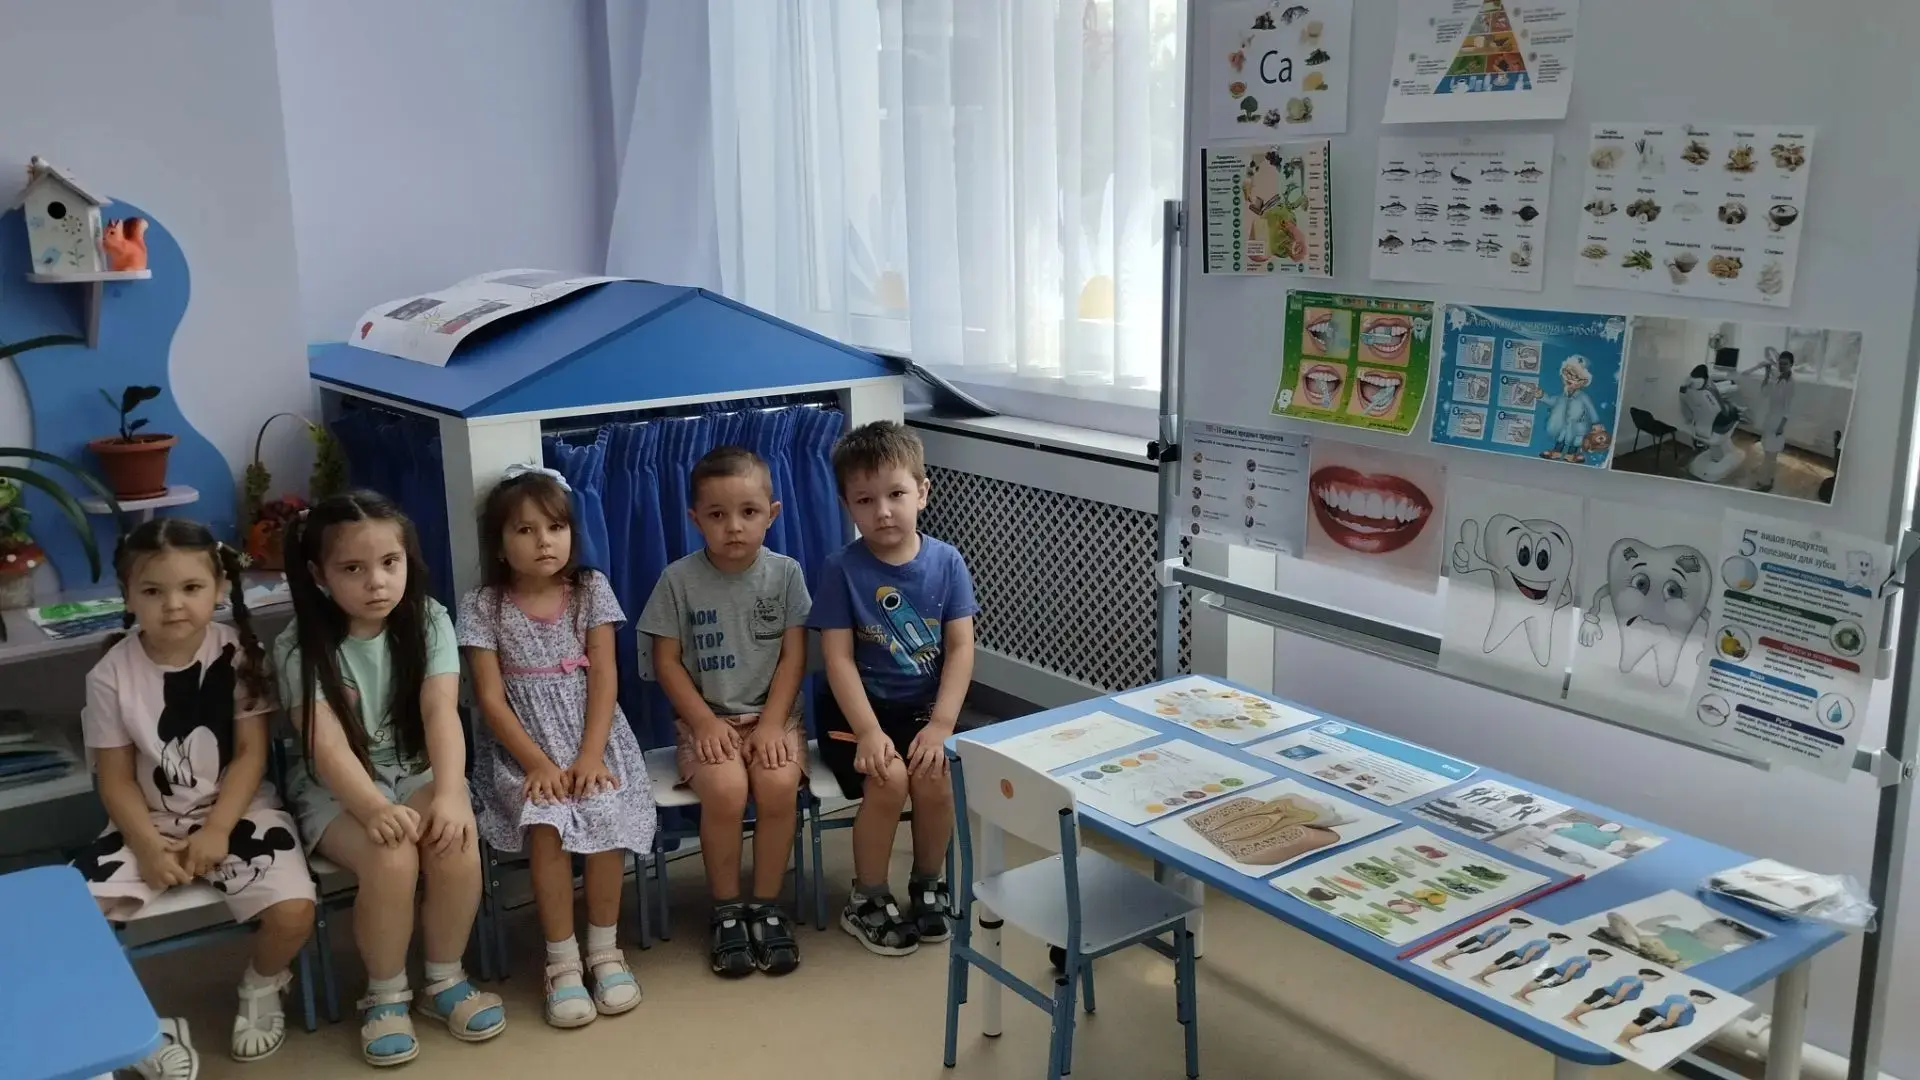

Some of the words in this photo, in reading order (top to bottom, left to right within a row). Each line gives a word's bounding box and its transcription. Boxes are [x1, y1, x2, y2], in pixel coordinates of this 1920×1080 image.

[1260, 50, 1293, 84] Ca
[1739, 528, 1759, 557] 5
[1761, 531, 1786, 545] видов
[693, 631, 725, 650] TOP
[1774, 716, 1792, 728] Рыба
